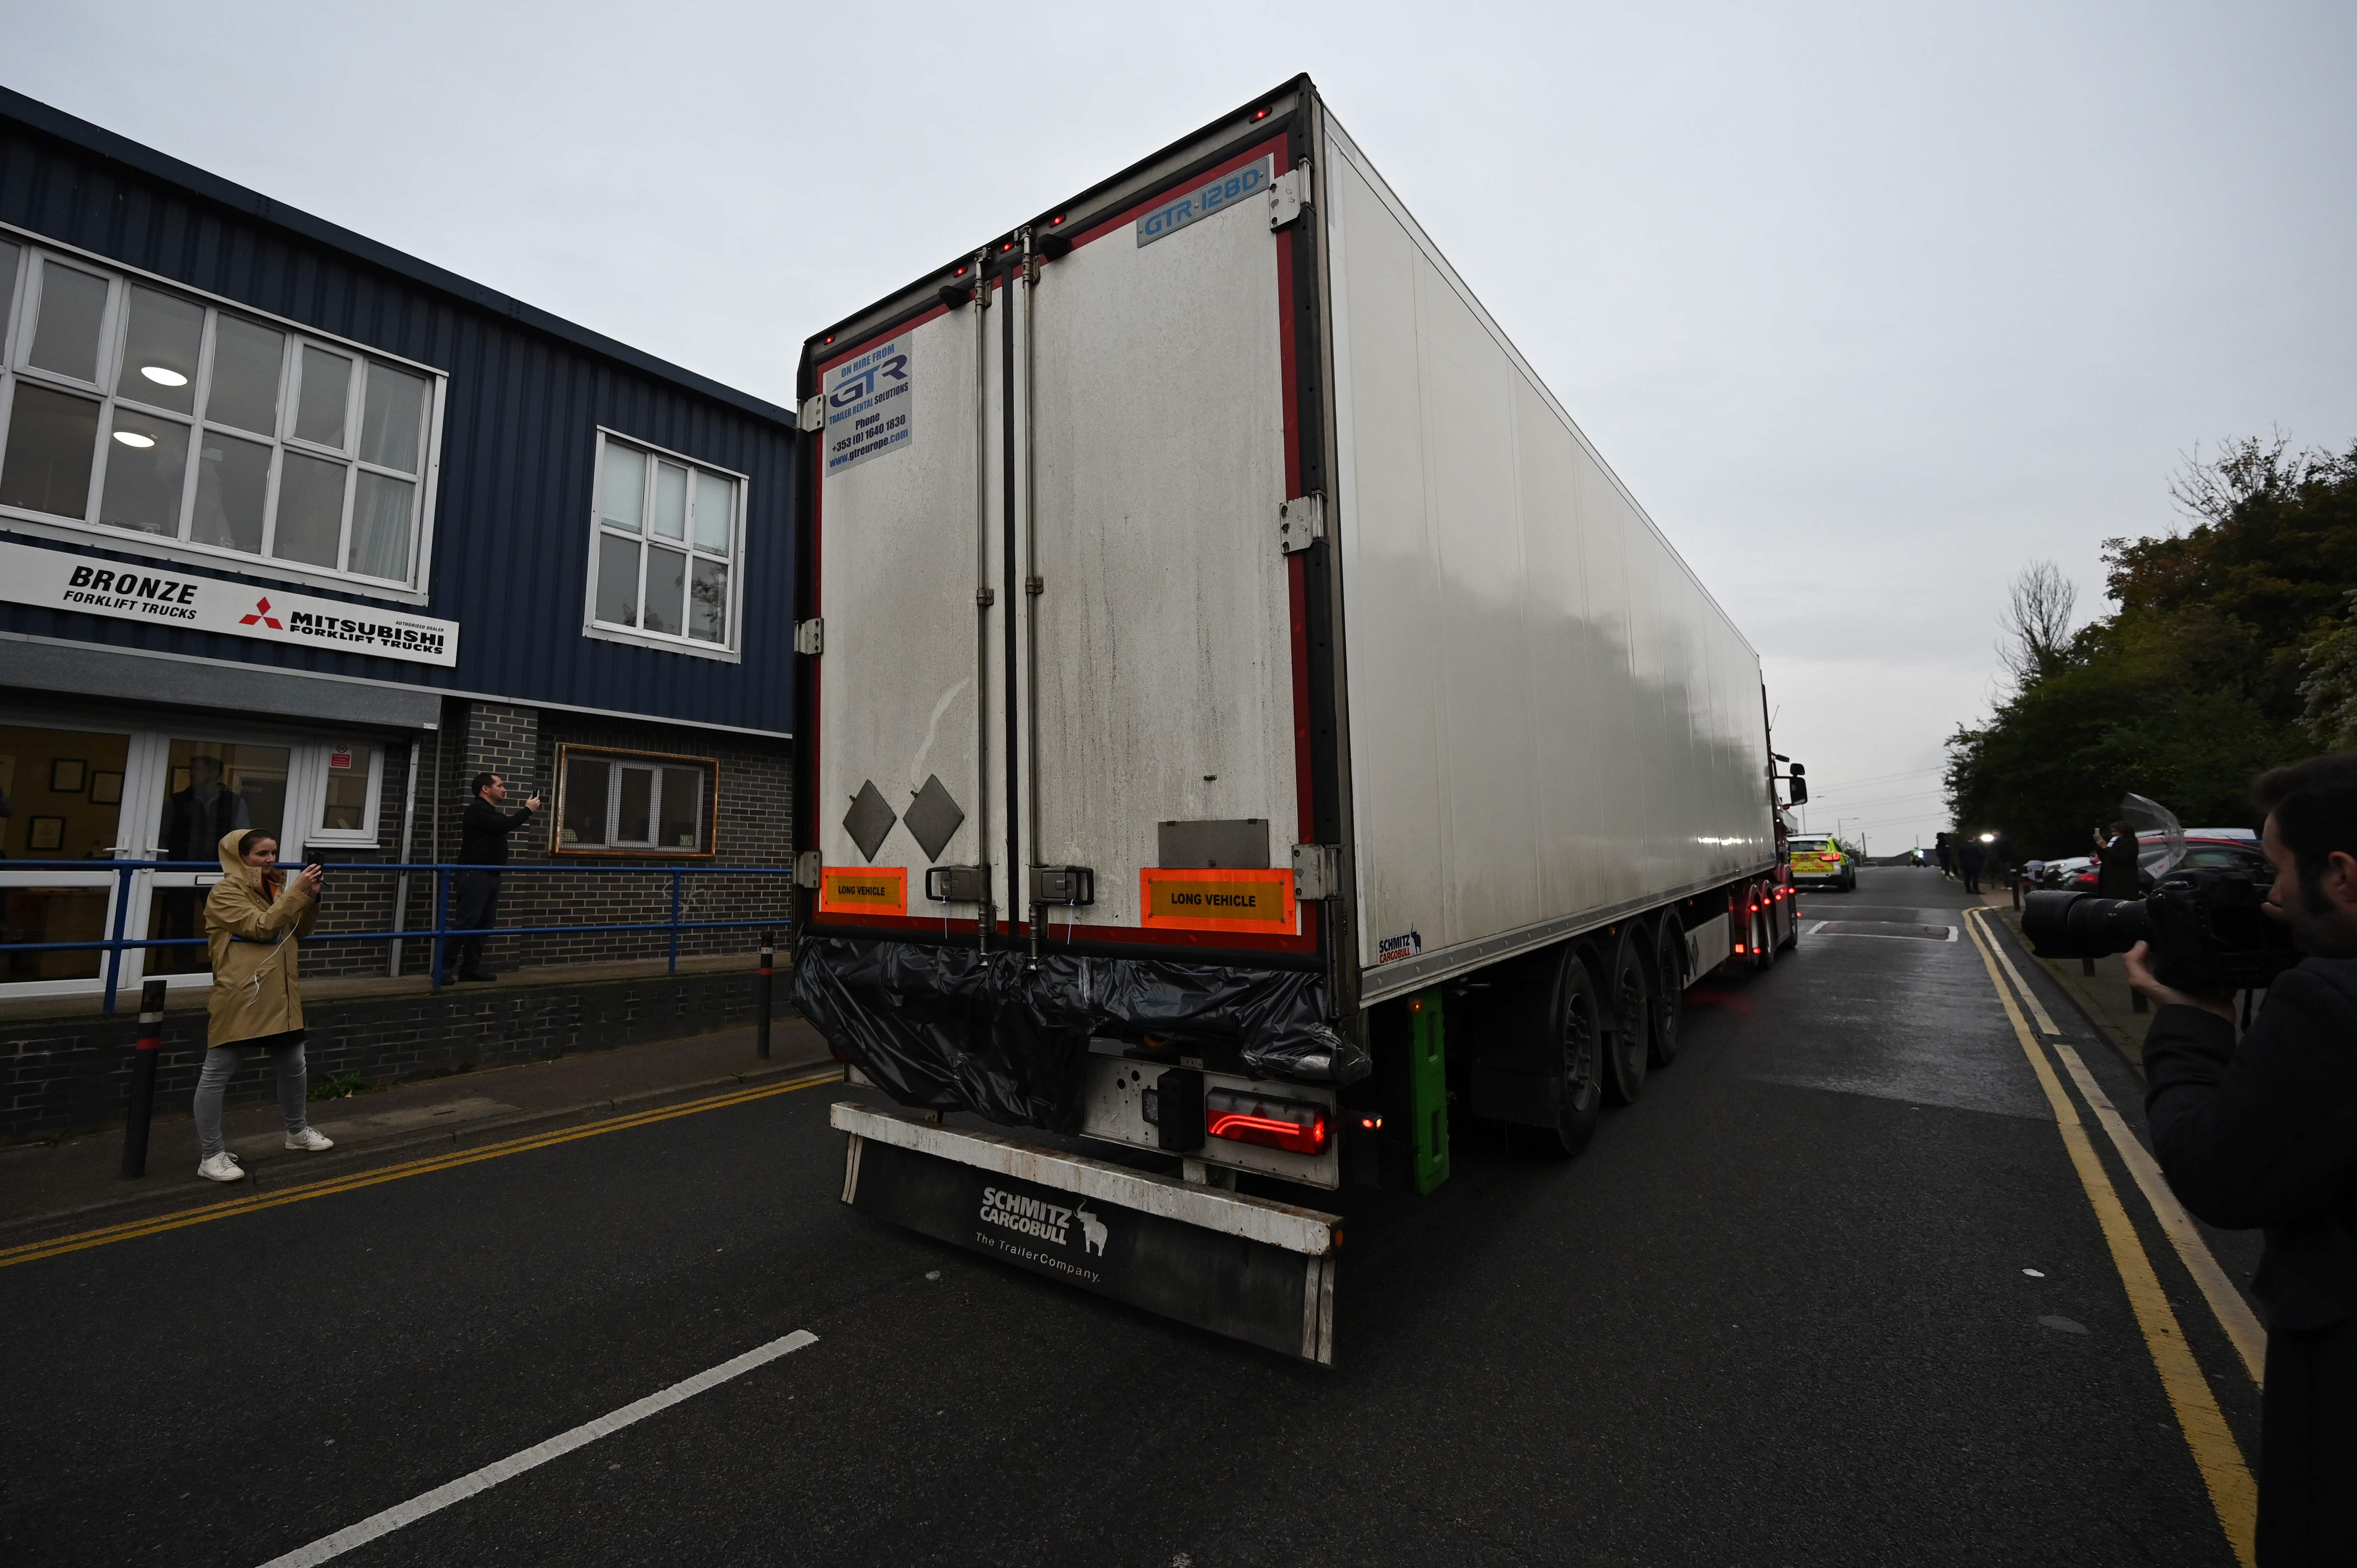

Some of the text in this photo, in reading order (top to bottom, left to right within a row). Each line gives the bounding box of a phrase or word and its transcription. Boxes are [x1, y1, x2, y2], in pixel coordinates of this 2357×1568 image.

[1145, 169, 1259, 236] GTR 128D
[841, 343, 894, 378] ON HIRE FROM
[830, 355, 908, 408] GTR
[829, 382, 908, 425] TRAILER RENTAL SOLUTIONS
[832, 414, 905, 452] +353 (0) 1640 1830
[855, 413, 880, 430] Phone
[830, 429, 908, 468] www.gtreurope.com
[69, 565, 198, 604] BRONZE
[63, 590, 197, 620] FORKLIFT TRUCKS
[290, 611, 444, 646] MITSUBISHI
[290, 625, 443, 654] FORKLIFT TRUCKS
[395, 621, 425, 629] AUTHORISED
[838, 886, 885, 896] LONG VEHICLE
[1171, 893, 1256, 907] LONG VEHICLE
[1379, 934, 1410, 953] SCHMITZ
[1380, 947, 1410, 964] CARGOBULL
[982, 1187, 1072, 1229] SCHMITZ
[976, 1232, 995, 1247] The
[980, 1206, 1067, 1246] CARGOBULL
